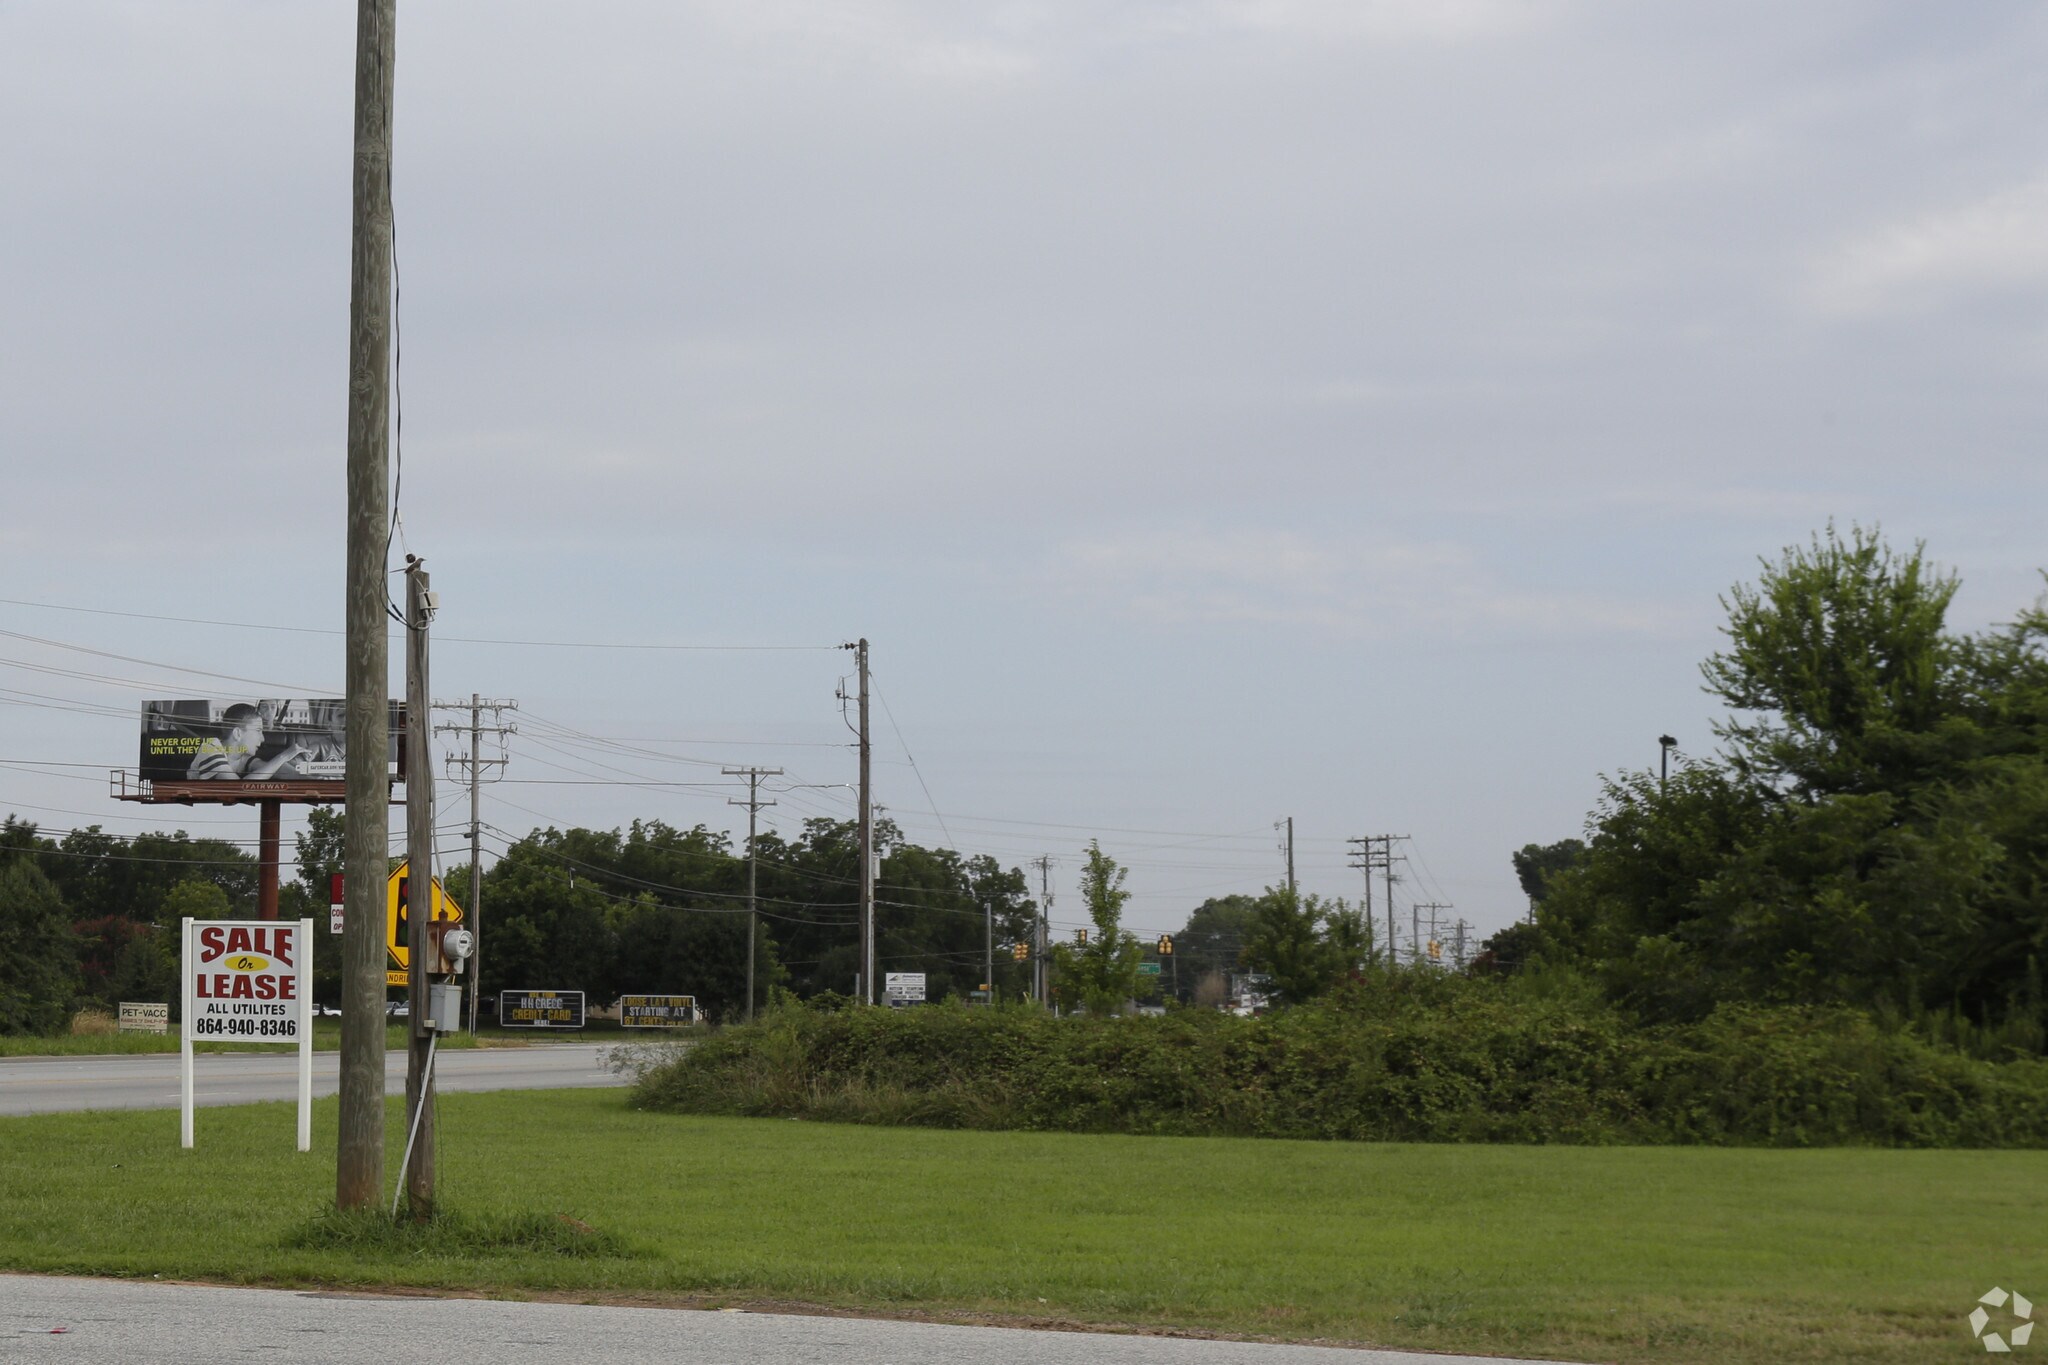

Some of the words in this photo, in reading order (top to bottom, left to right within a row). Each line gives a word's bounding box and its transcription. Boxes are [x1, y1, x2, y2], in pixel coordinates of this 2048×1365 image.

[150, 738, 178, 746] NEVER
[180, 738, 200, 746] GIVE
[150, 746, 175, 755] UNTIL
[177, 746, 199, 754] THEY
[245, 783, 286, 791] FAIRWAY
[200, 927, 293, 968] SALE
[237, 957, 254, 970] Or
[197, 974, 296, 1000] LEASE
[623, 997, 647, 1006] LOOSE
[650, 998, 665, 1007] LAY
[668, 998, 692, 1007] VINYL
[122, 1008, 167, 1018] PET-VACC
[207, 1003, 228, 1014] ALL
[233, 1004, 286, 1015] UTILITES
[629, 1007, 669, 1017] STARTING
[673, 1007, 685, 1017] AT
[512, 1009, 544, 1020] CREDIT
[548, 1009, 571, 1020] CARD
[197, 1018, 296, 1036] 864-940-8346
